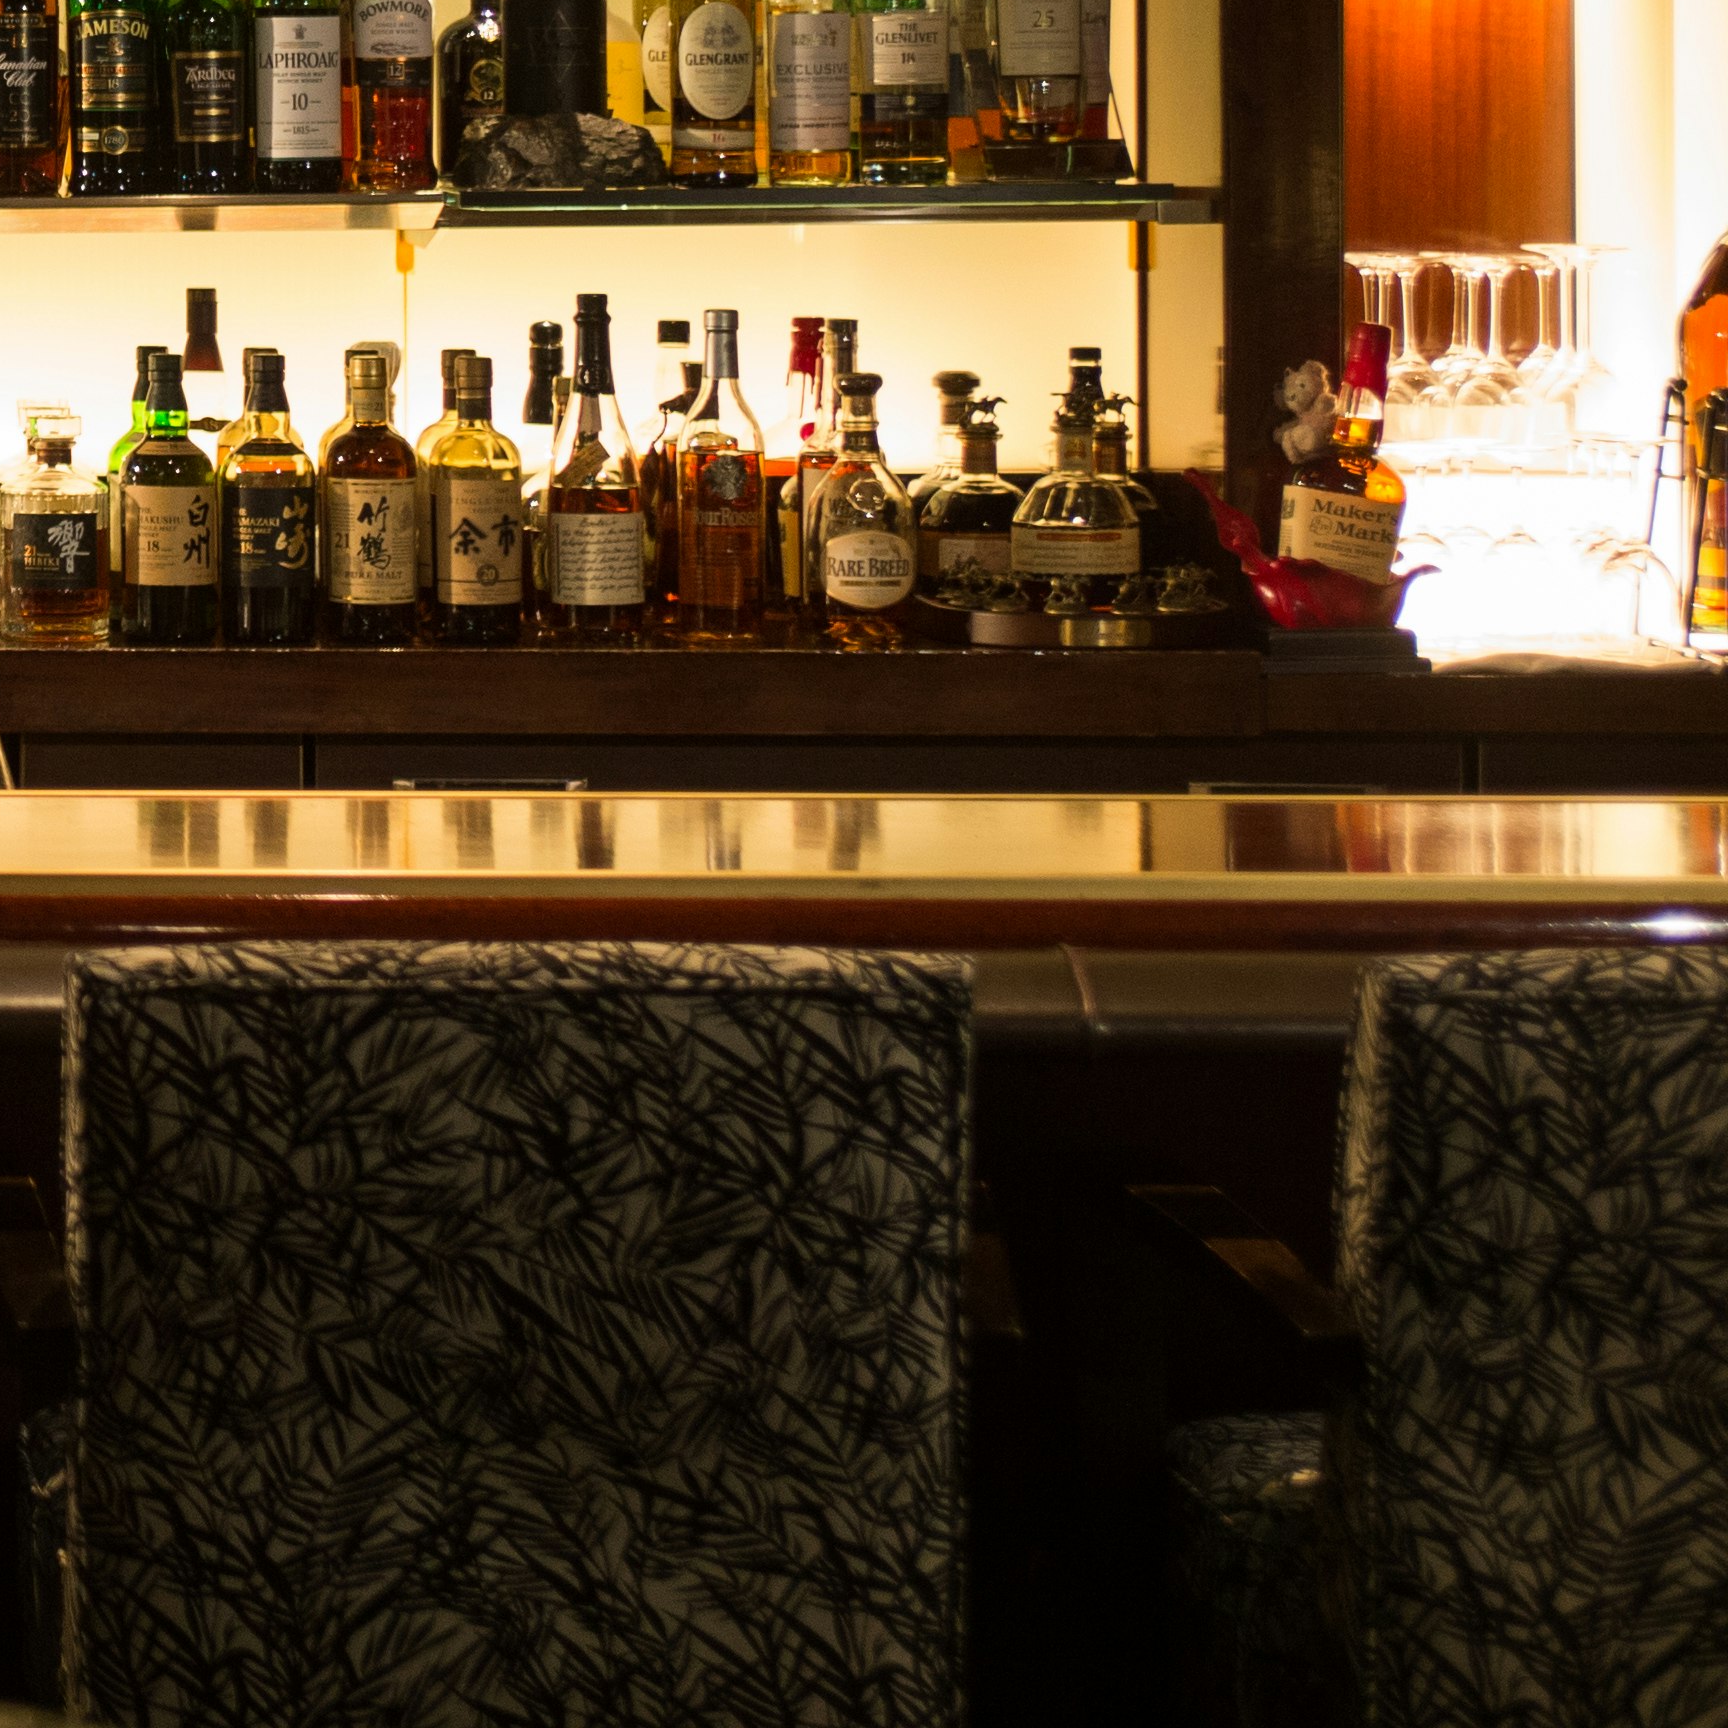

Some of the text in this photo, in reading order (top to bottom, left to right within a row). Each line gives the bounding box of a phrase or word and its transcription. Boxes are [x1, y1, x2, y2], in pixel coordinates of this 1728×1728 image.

[358, 0, 429, 24] BOWMORE
[1031, 9, 1054, 28] 25
[75, 17, 151, 41] JAMESON
[898, 22, 919, 34] THE
[875, 31, 938, 46] GLENLIVET
[256, 51, 339, 70] LAPHROAIG
[647, 49, 670, 63] GLE
[685, 52, 753, 66] GLENGRANT
[388, 64, 402, 77] 12
[775, 61, 849, 76] EXCLUSIVE
[3, 72, 35, 88] Club
[291, 92, 309, 111] 10
[483, 90, 495, 100] 12
[1312, 498, 1399, 528] Maker's
[182, 493, 211, 570] 白州
[275, 494, 311, 570] 山崎
[334, 532, 350, 550] 21
[448, 513, 519, 557] 余市
[1334, 521, 1394, 546] Mark
[47, 518, 91, 574] 響
[146, 540, 161, 553] 18
[24, 556, 60, 567] HIBIKI
[826, 557, 910, 579] RARE BREED
